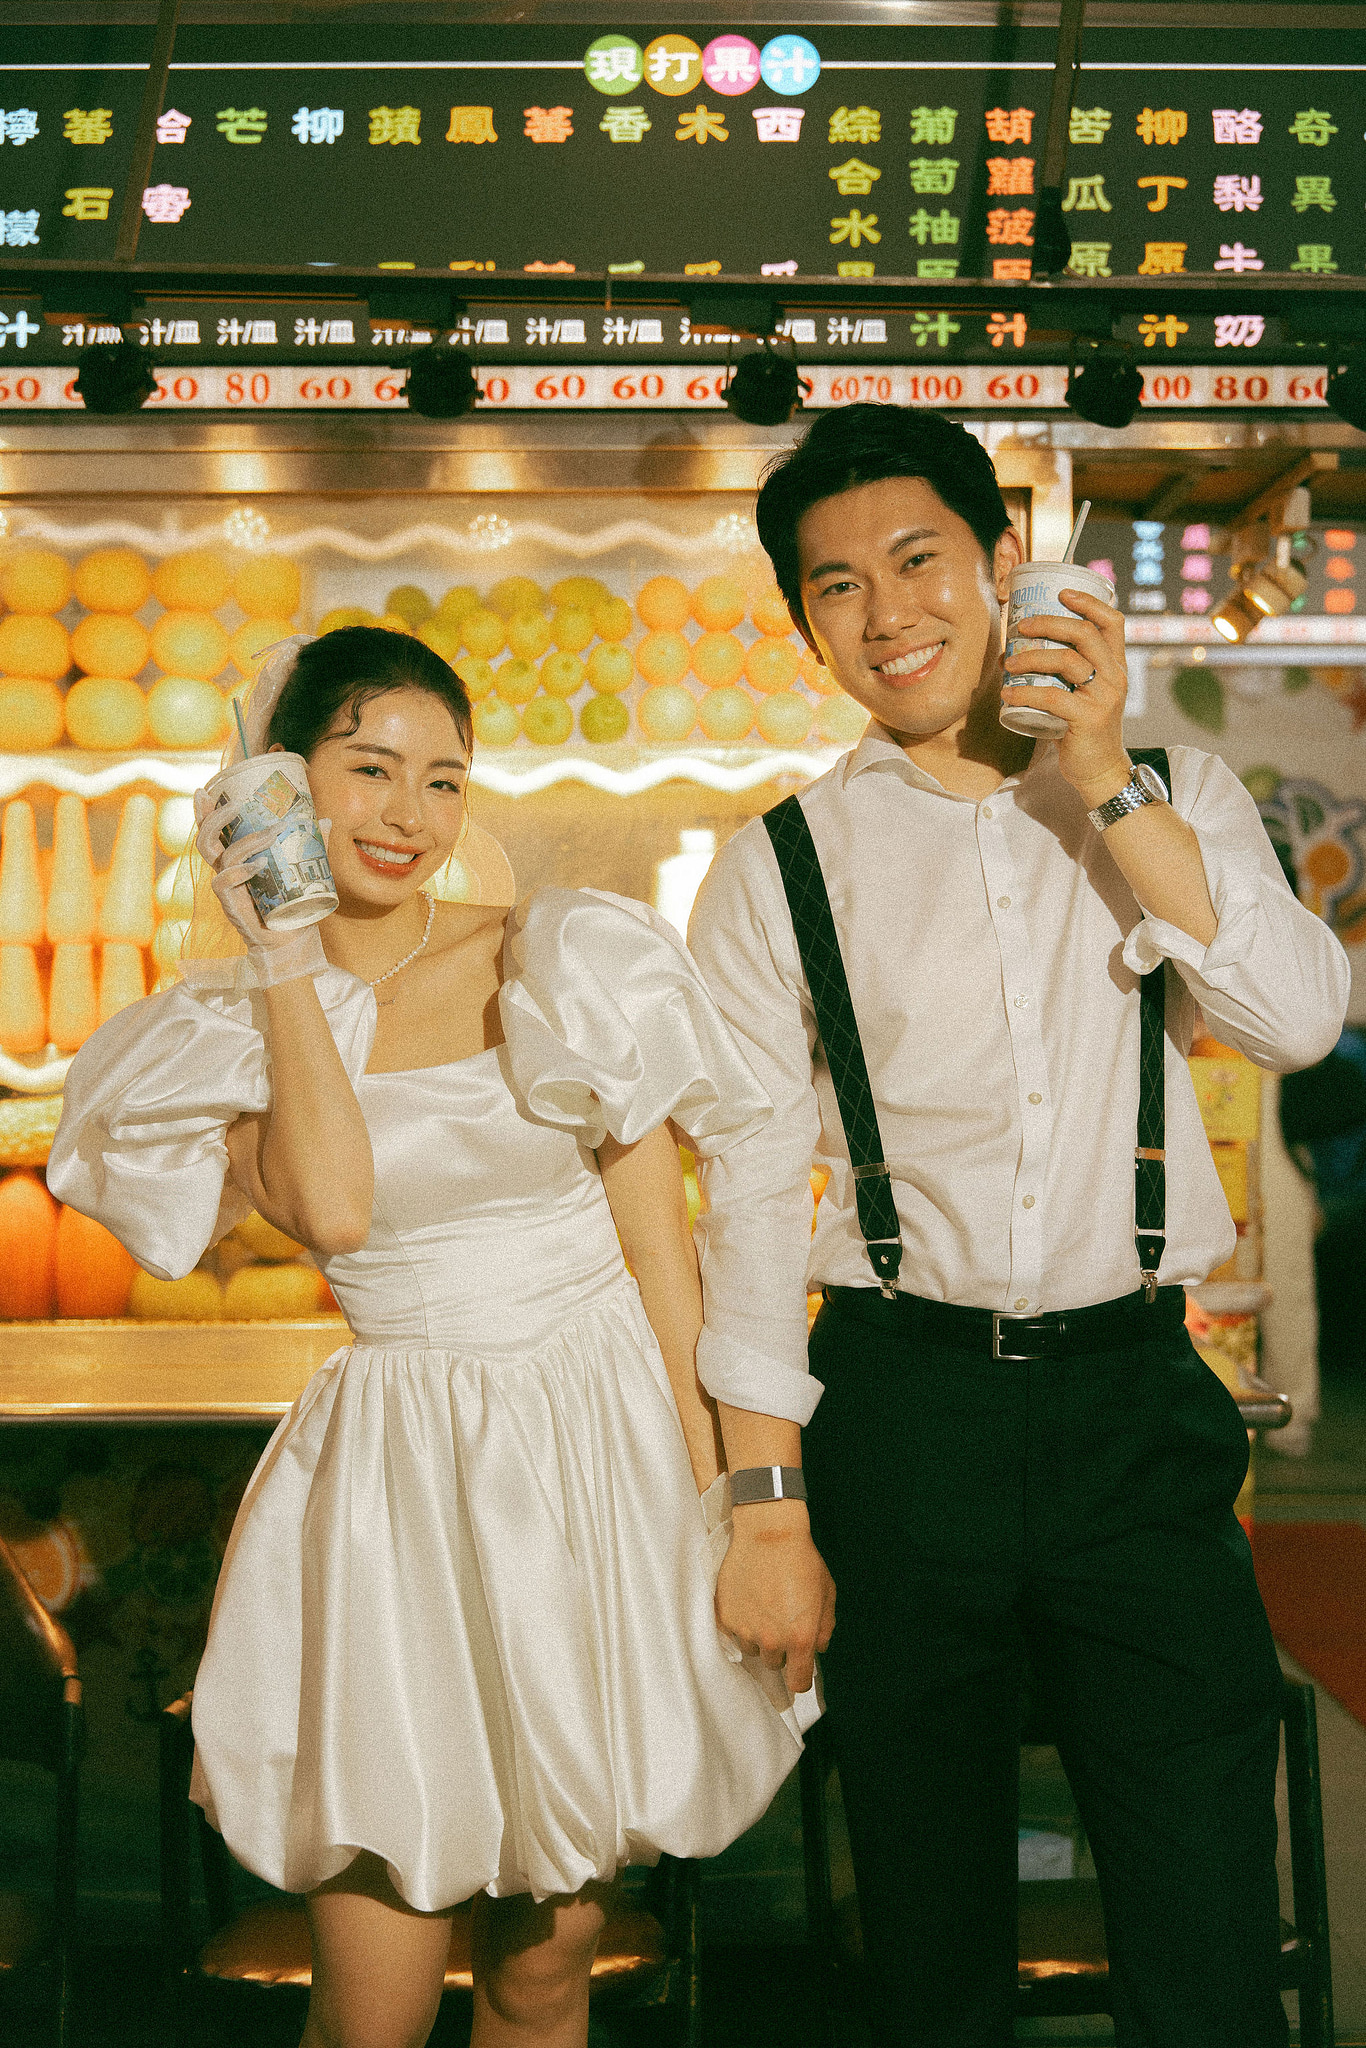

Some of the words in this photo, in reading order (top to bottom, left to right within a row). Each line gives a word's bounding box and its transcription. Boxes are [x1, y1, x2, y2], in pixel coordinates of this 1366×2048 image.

[589, 46, 817, 83] 現打果汁
[291, 106, 345, 145] 柳
[599, 105, 652, 143] 香
[675, 104, 729, 144] 木
[752, 107, 805, 142] 西
[225, 372, 270, 404] 80
[299, 376, 351, 401] 60
[534, 374, 586, 401] 60
[612, 374, 666, 401] 60
[910, 374, 963, 401] 100
[986, 373, 1040, 400] 60
[1213, 375, 1269, 401] 80
